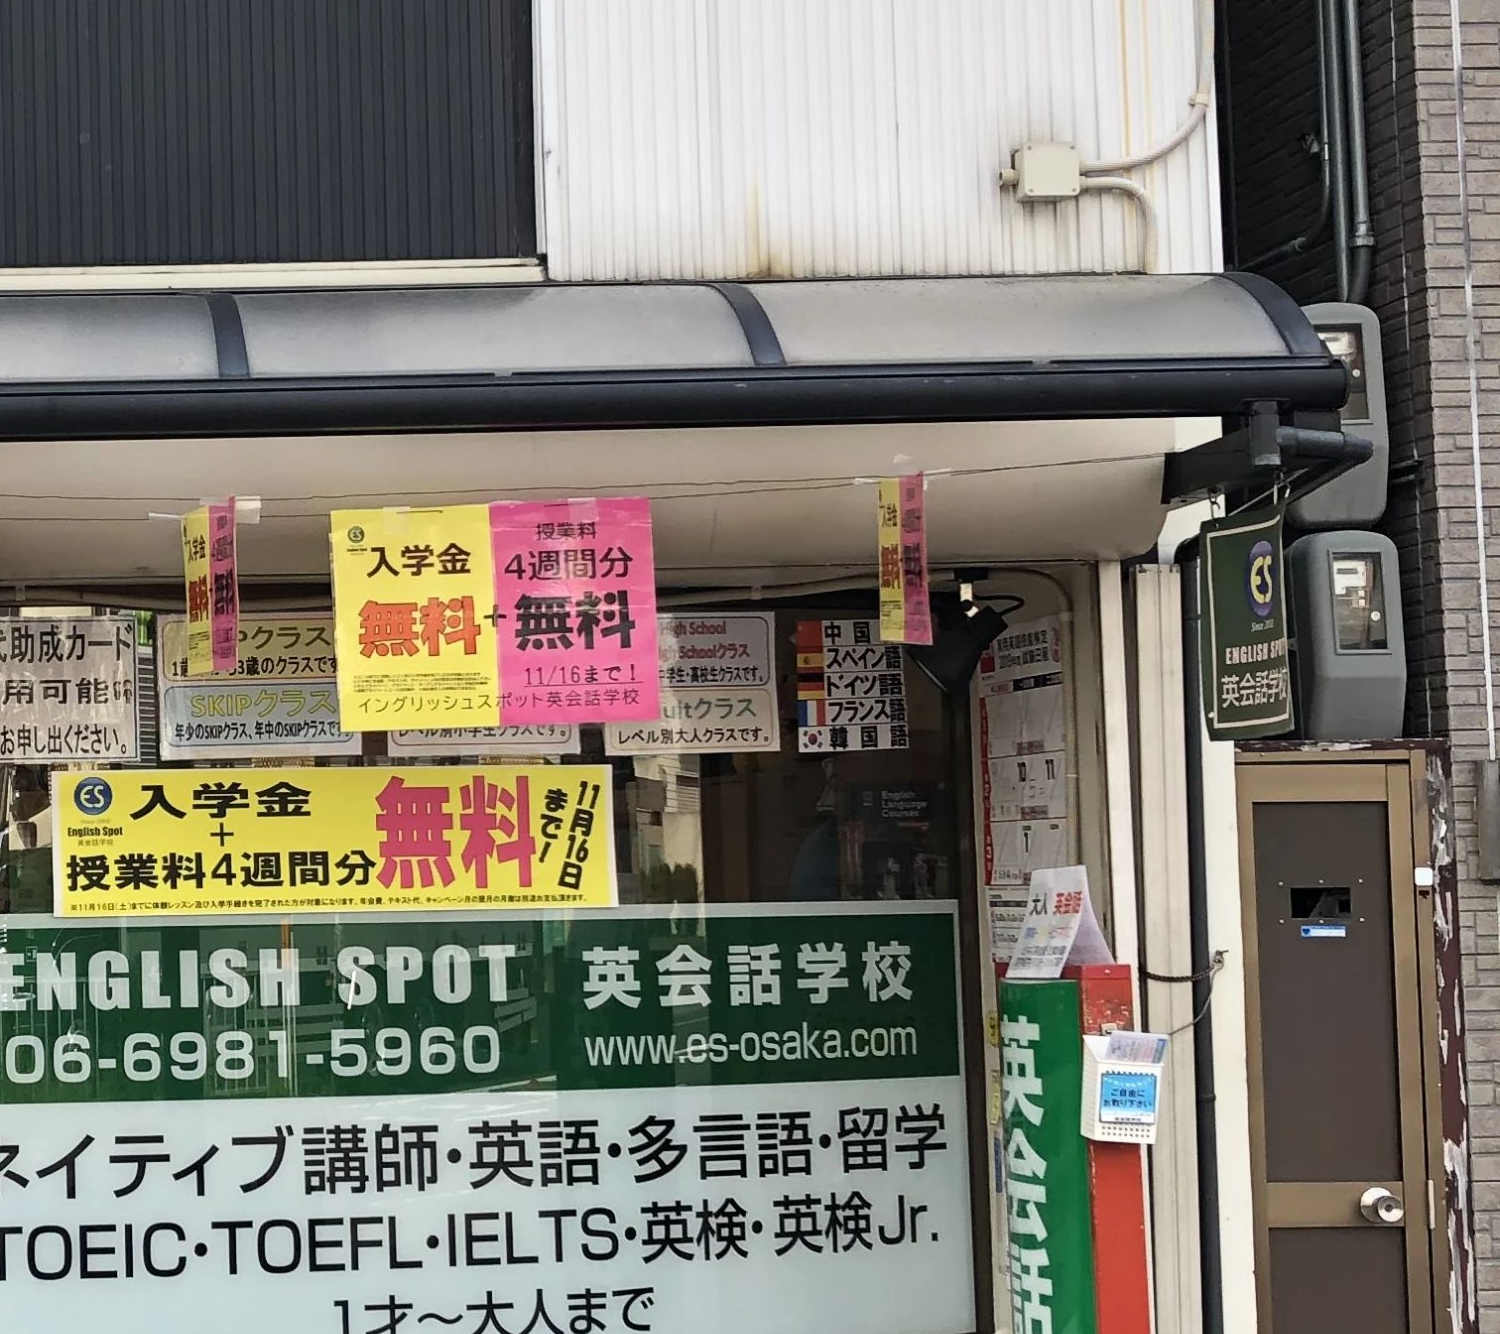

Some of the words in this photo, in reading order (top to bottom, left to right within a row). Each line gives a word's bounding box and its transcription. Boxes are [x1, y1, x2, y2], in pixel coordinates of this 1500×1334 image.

[536, 522, 597, 541] 授業料
[366, 542, 472, 578] 入学金
[504, 547, 633, 581] 4週間分
[1250, 554, 1273, 604] ES
[358, 595, 482, 659] 無料
[515, 590, 636, 652] 無料
[688, 620, 727, 636] School
[826, 646, 902, 670] スペイン語
[1226, 642, 1269, 665] ENGLISH
[827, 673, 902, 697] ドイツ語
[191, 690, 337, 718] SKIPクラス
[828, 699, 906, 723] フランス語
[618, 727, 769, 745] レベル別大人クラスです。
[829, 725, 908, 749] 韓国語
[79, 785, 105, 808] ES
[129, 781, 313, 821] 入学金
[881, 790, 917, 801] English
[881, 801, 928, 810] Language
[539, 788, 569, 863] まで！
[881, 809, 920, 818] Courses
[67, 826, 100, 838] English
[102, 826, 123, 838] Spot
[375, 775, 536, 889] 無料
[558, 780, 601, 890] 11月16日
[66, 848, 377, 892] 授業料4週間分
[336, 944, 516, 1005] SPOT
[582, 940, 914, 1010] 英会話学校
[5, 1027, 501, 1084] 06-6981-5960
[584, 1022, 918, 1067] www.es-osaka.com
[1103, 1098, 1152, 1109] お取り下さい
[1110, 1087, 1146, 1098] ご自由に
